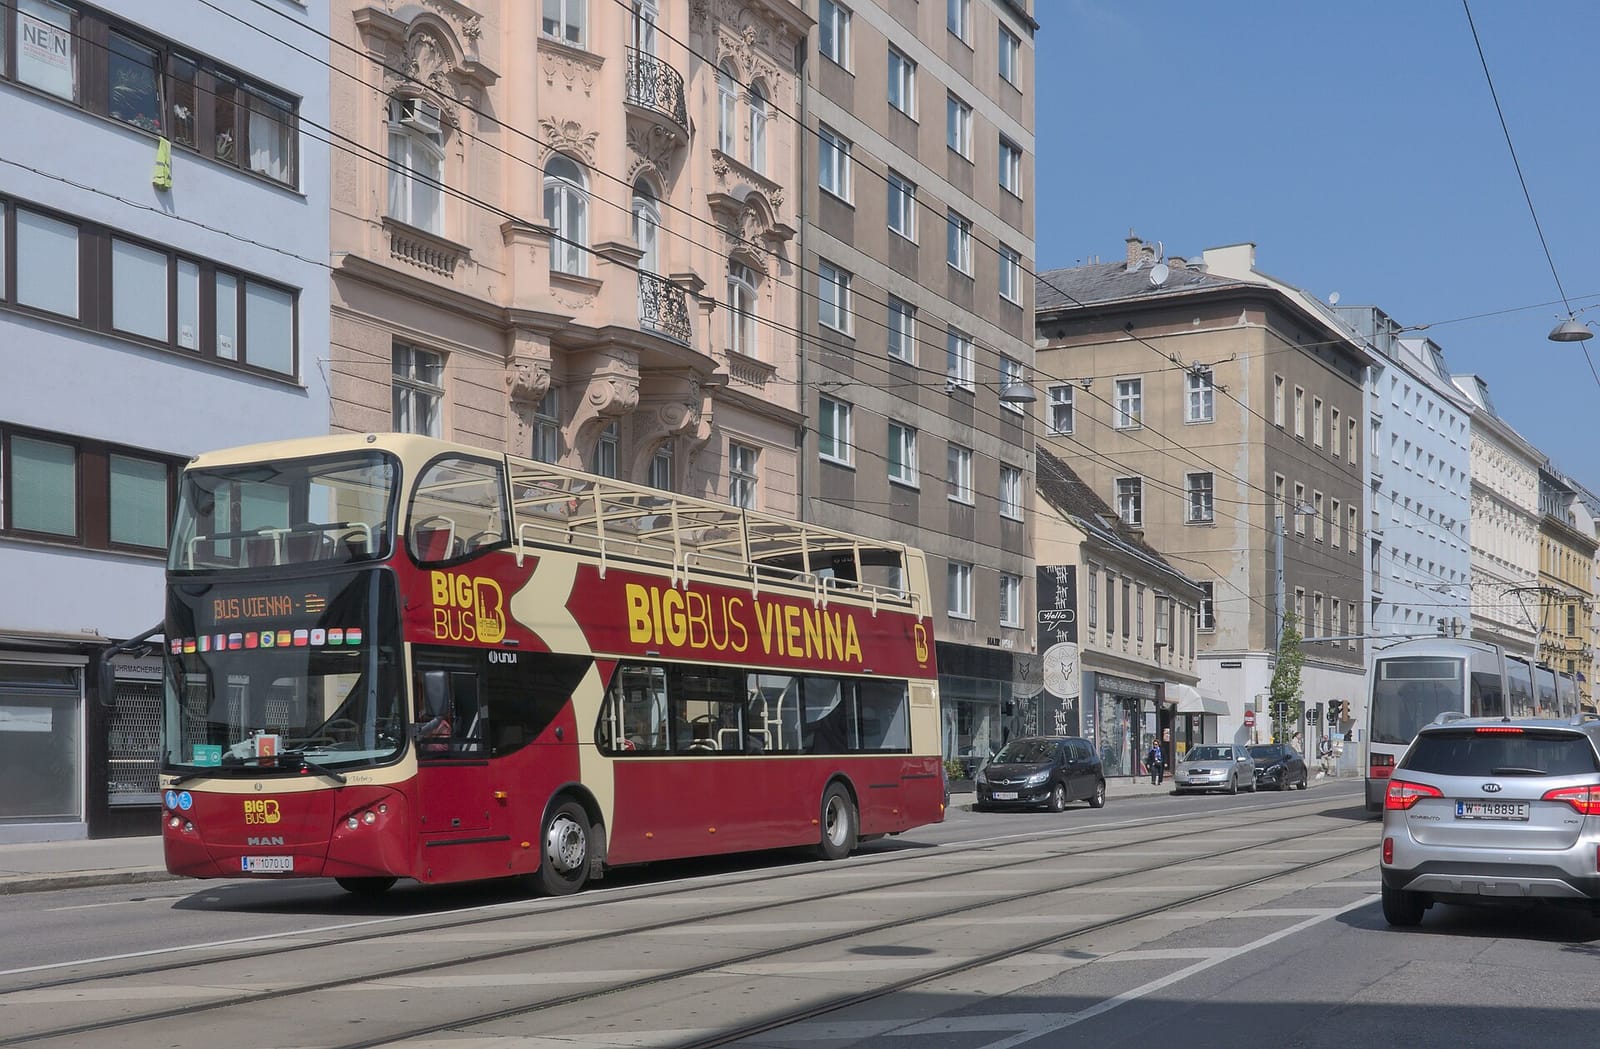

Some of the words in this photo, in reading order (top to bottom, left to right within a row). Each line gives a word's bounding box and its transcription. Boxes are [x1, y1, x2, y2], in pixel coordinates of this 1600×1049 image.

[431, 570, 473, 608] BIG
[214, 598, 240, 619] BUS
[242, 595, 293, 617] VIENNA
[1043, 612, 1067, 620] Hello
[433, 608, 476, 642] BUS
[754, 601, 862, 663] VIENNA
[244, 800, 264, 812] BIG
[1483, 804, 1515, 815] 14889
[245, 812, 266, 825] BUS
[247, 836, 285, 846] MAN
